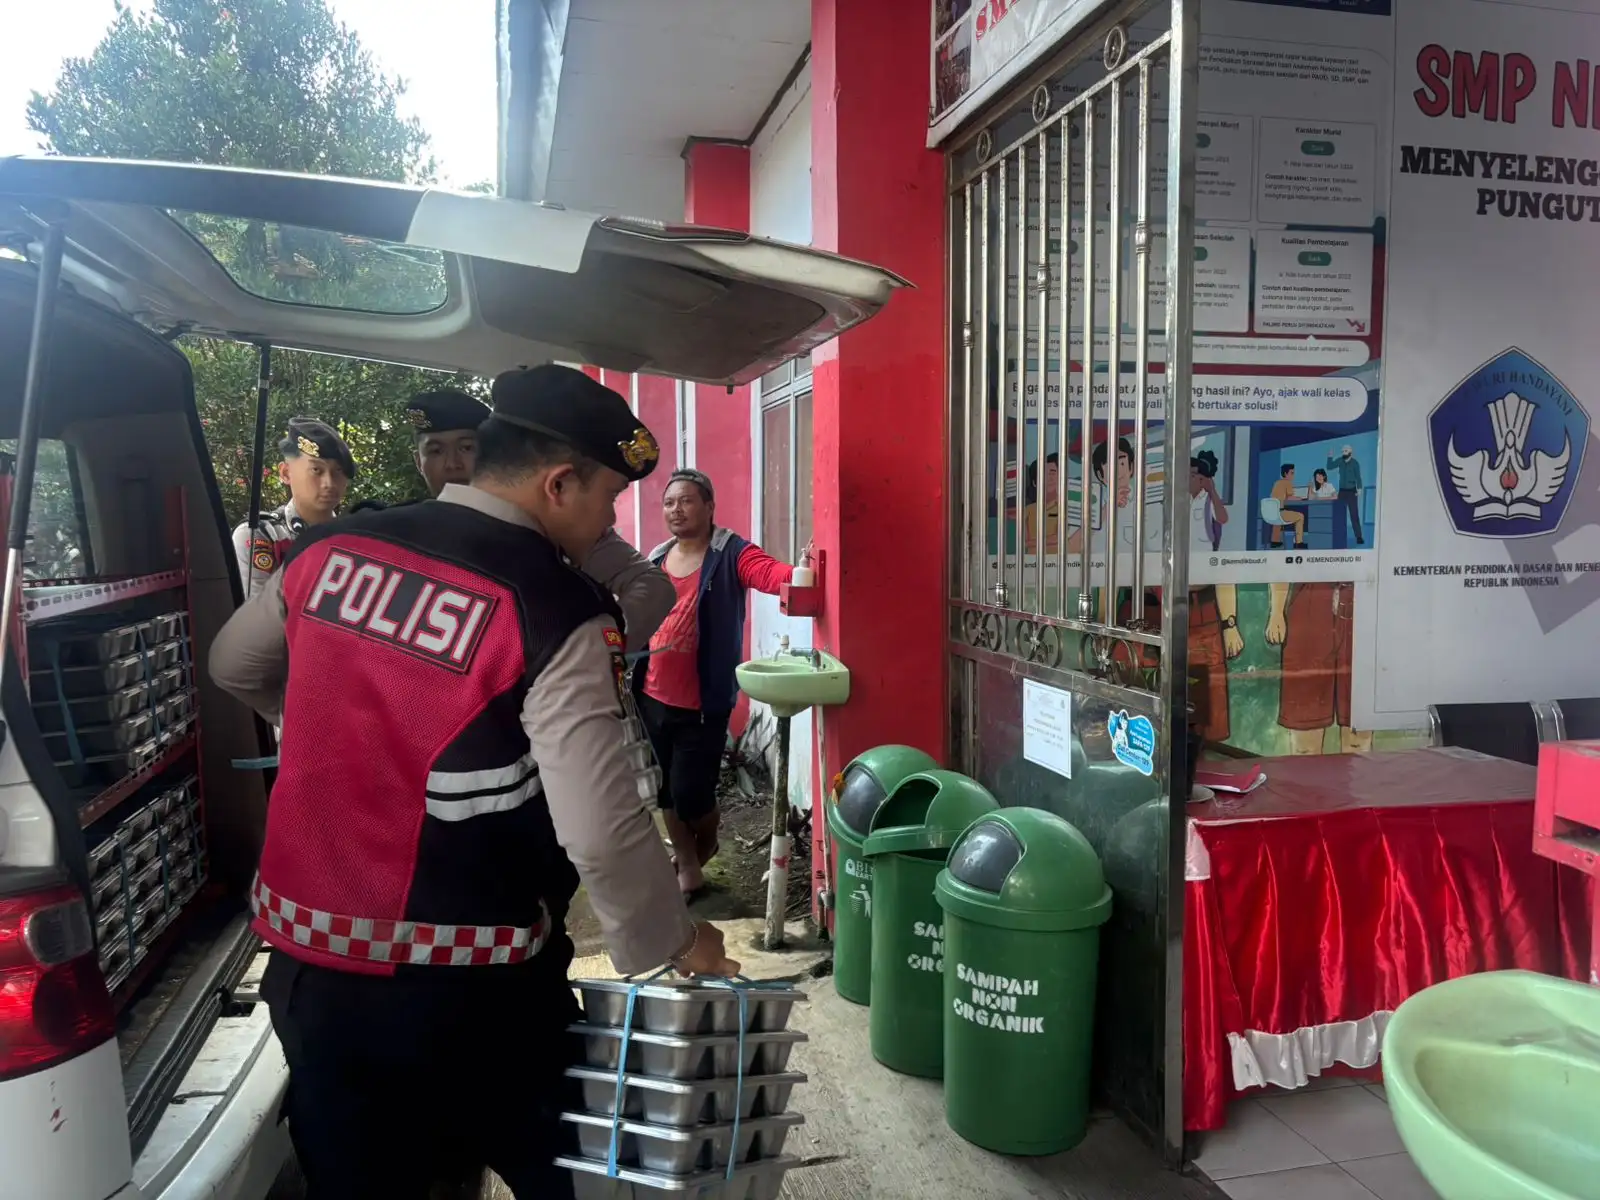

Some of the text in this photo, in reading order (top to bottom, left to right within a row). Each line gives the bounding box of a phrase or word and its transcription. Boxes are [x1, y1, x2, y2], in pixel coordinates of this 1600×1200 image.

[1413, 43, 1537, 124] SMP
[1295, 127, 1342, 136] Karakter Murid
[1307, 239, 1349, 247] Pembelajaran
[1205, 386, 1230, 396] hasil
[1232, 386, 1250, 396] ini?
[1253, 388, 1275, 398] Ayo,
[1278, 387, 1298, 398] ajak
[1301, 388, 1322, 397] wali
[1324, 389, 1351, 398] kelas
[1510, 370, 1573, 416] HANDAYANI
[1197, 400, 1242, 410] bertukar
[1245, 401, 1278, 411] solusi!
[1306, 556, 1354, 564] KEMENDIKBUD
[1393, 565, 1461, 576] KEMENTERIAN
[1465, 564, 1521, 575] PENDIDIKAN
[1522, 563, 1553, 574] DASAR
[1555, 563, 1573, 573] DAN
[1463, 576, 1559, 588] REPUBLIK INDONESIA
[306, 553, 488, 664] POLISI
[956, 962, 1039, 996] SAMPAH
[972, 987, 1017, 1013] NON
[953, 997, 1045, 1034] ORGANIK
